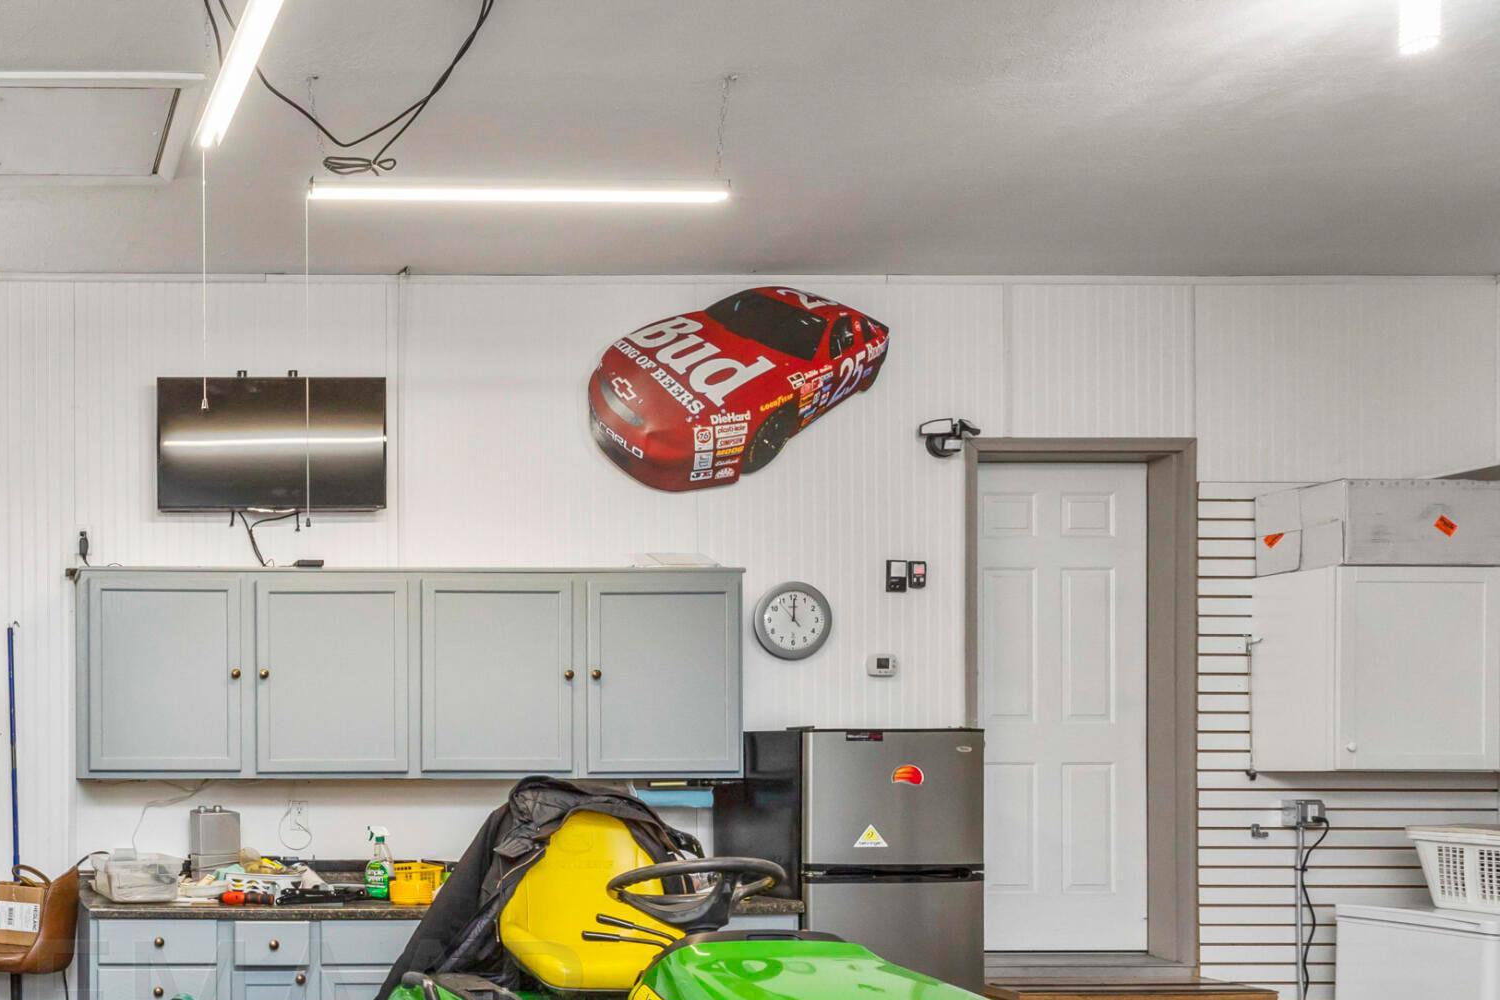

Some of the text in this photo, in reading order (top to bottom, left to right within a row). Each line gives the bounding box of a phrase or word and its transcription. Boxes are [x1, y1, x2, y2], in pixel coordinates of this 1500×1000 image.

[613, 339, 705, 415] KING OF BEERS
[628, 316, 776, 407] Bud
[826, 350, 866, 407] 25
[710, 410, 751, 425] DieHard
